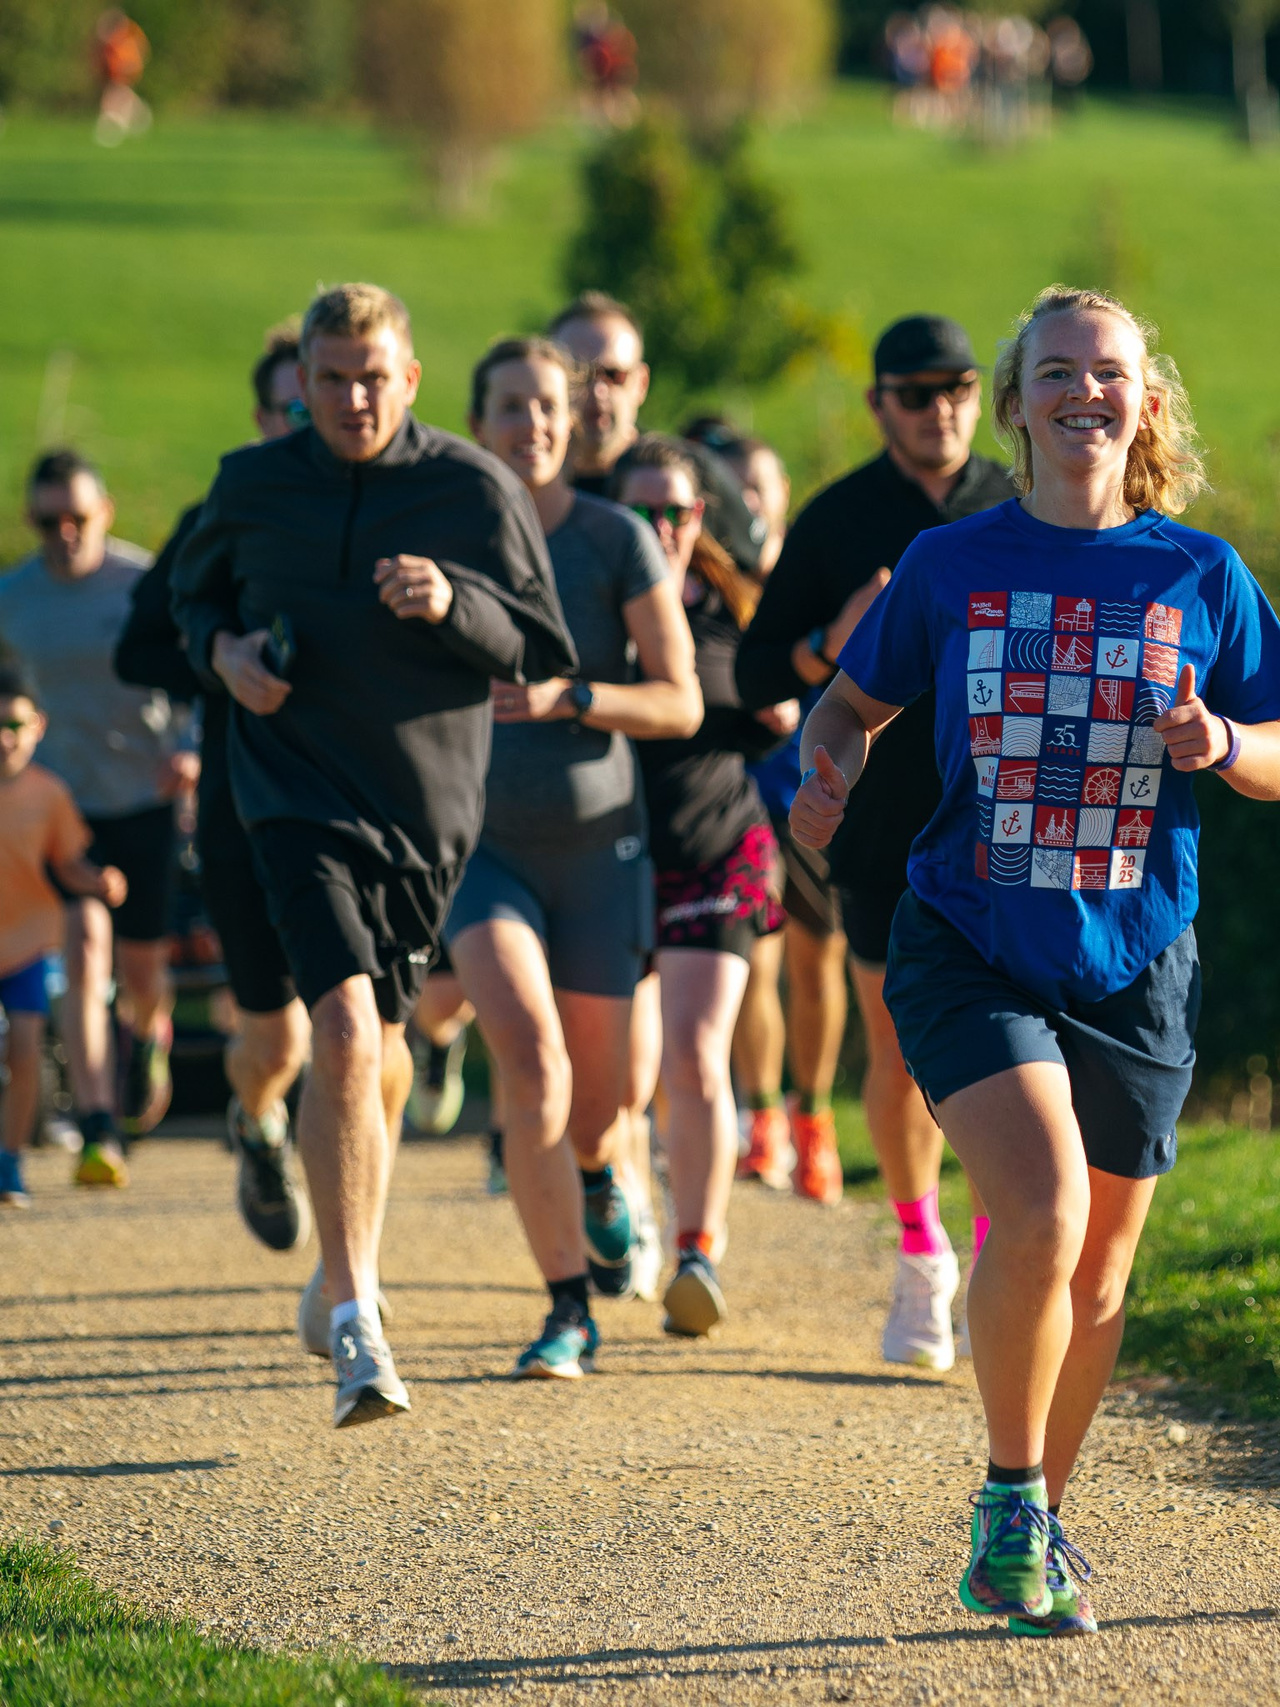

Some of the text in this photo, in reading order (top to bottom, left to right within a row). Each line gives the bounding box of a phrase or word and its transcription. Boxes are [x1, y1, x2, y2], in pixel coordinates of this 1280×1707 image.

[1053, 724, 1076, 747] 35
[988, 765, 996, 776] 10
[981, 775, 995, 789] MILE
[1120, 854, 1136, 868] 20
[1118, 869, 1134, 884] 25
